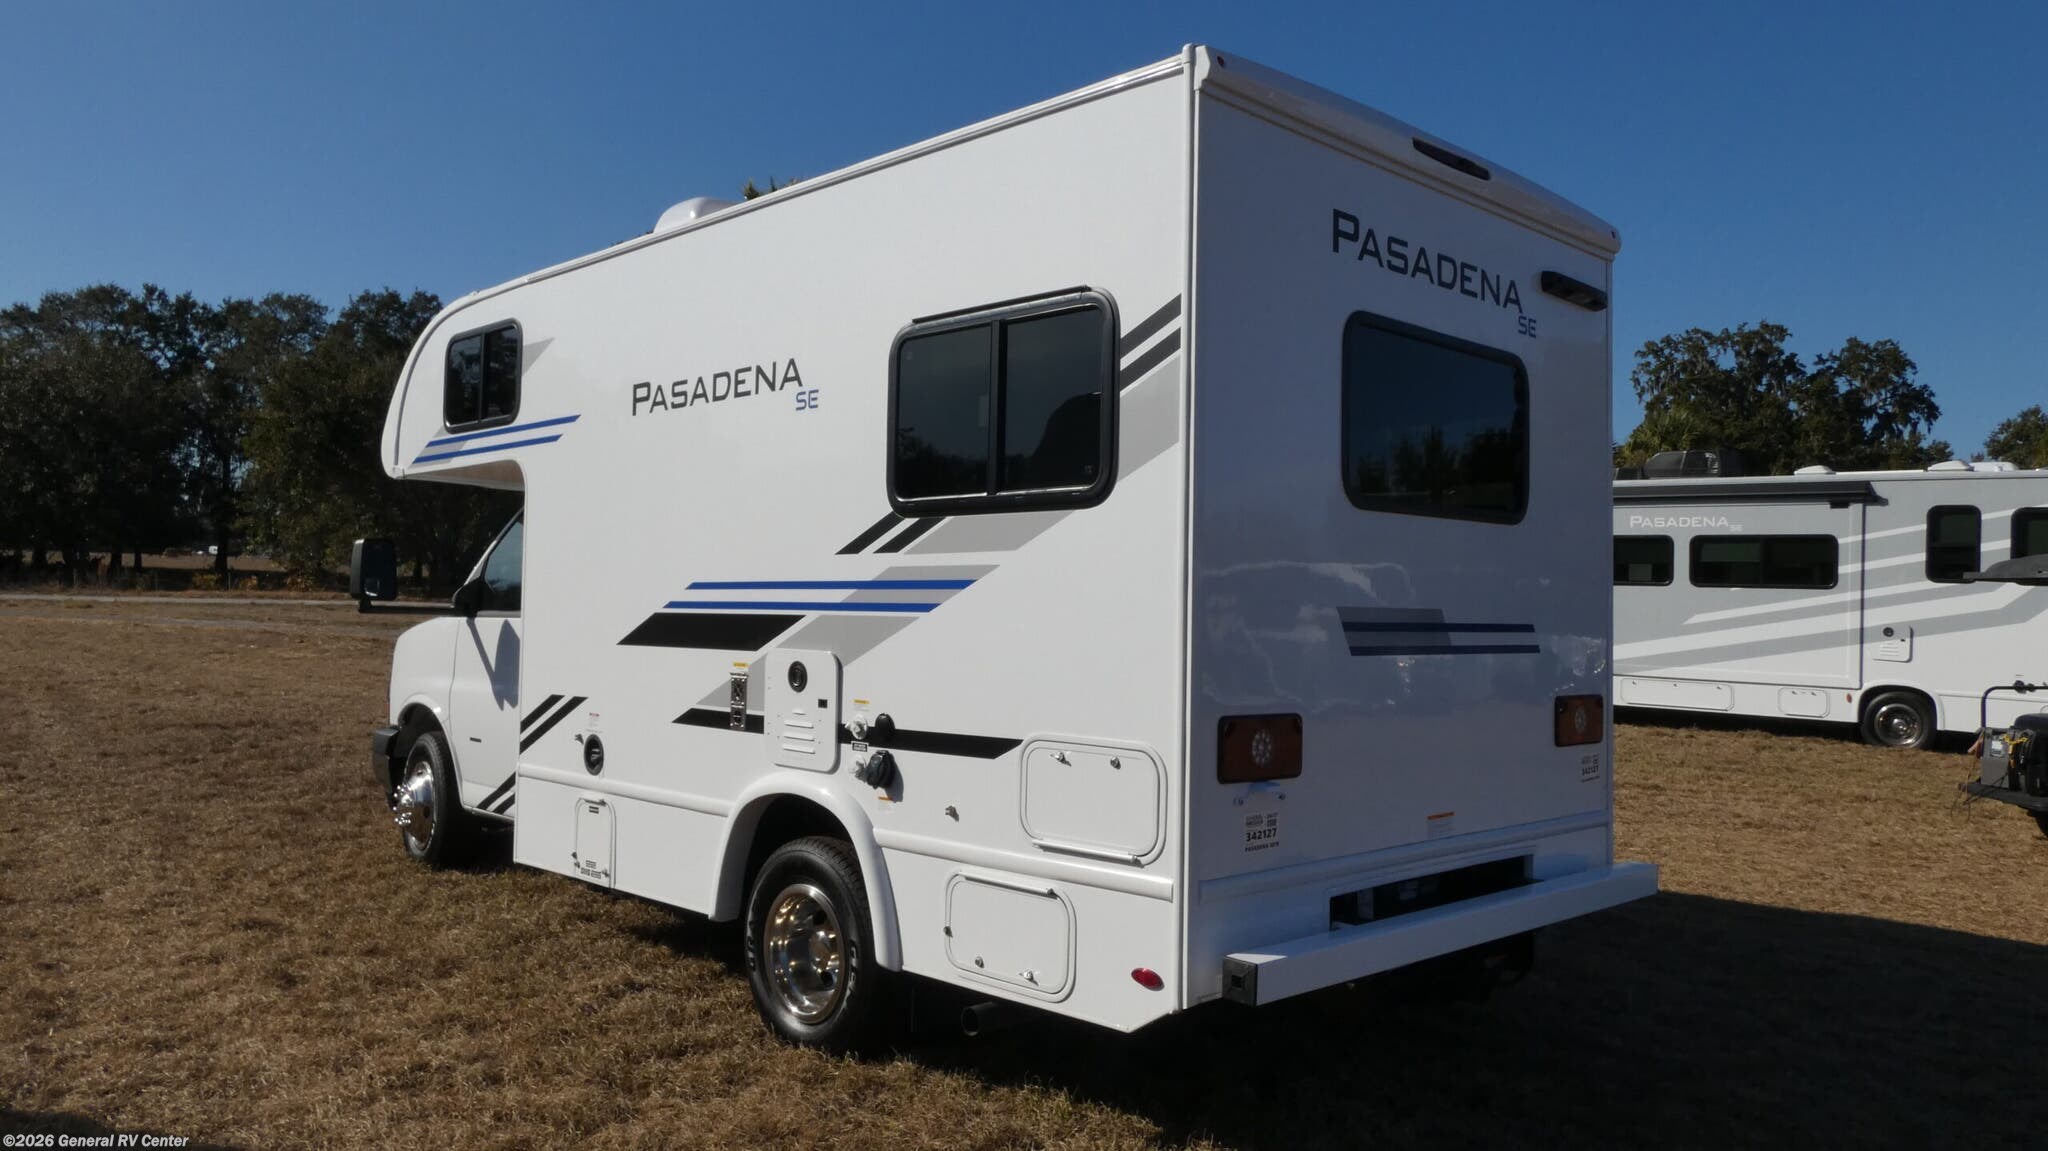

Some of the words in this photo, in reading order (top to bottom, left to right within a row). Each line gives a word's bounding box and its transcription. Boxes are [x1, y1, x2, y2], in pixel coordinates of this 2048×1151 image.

[1332, 208, 1523, 314] PASADENA
[1517, 315, 1537, 339] SE
[632, 358, 803, 416] PASADENA
[795, 389, 819, 411] SE
[1629, 515, 1729, 529] PASADENA
[1245, 827, 1277, 842] 342127
